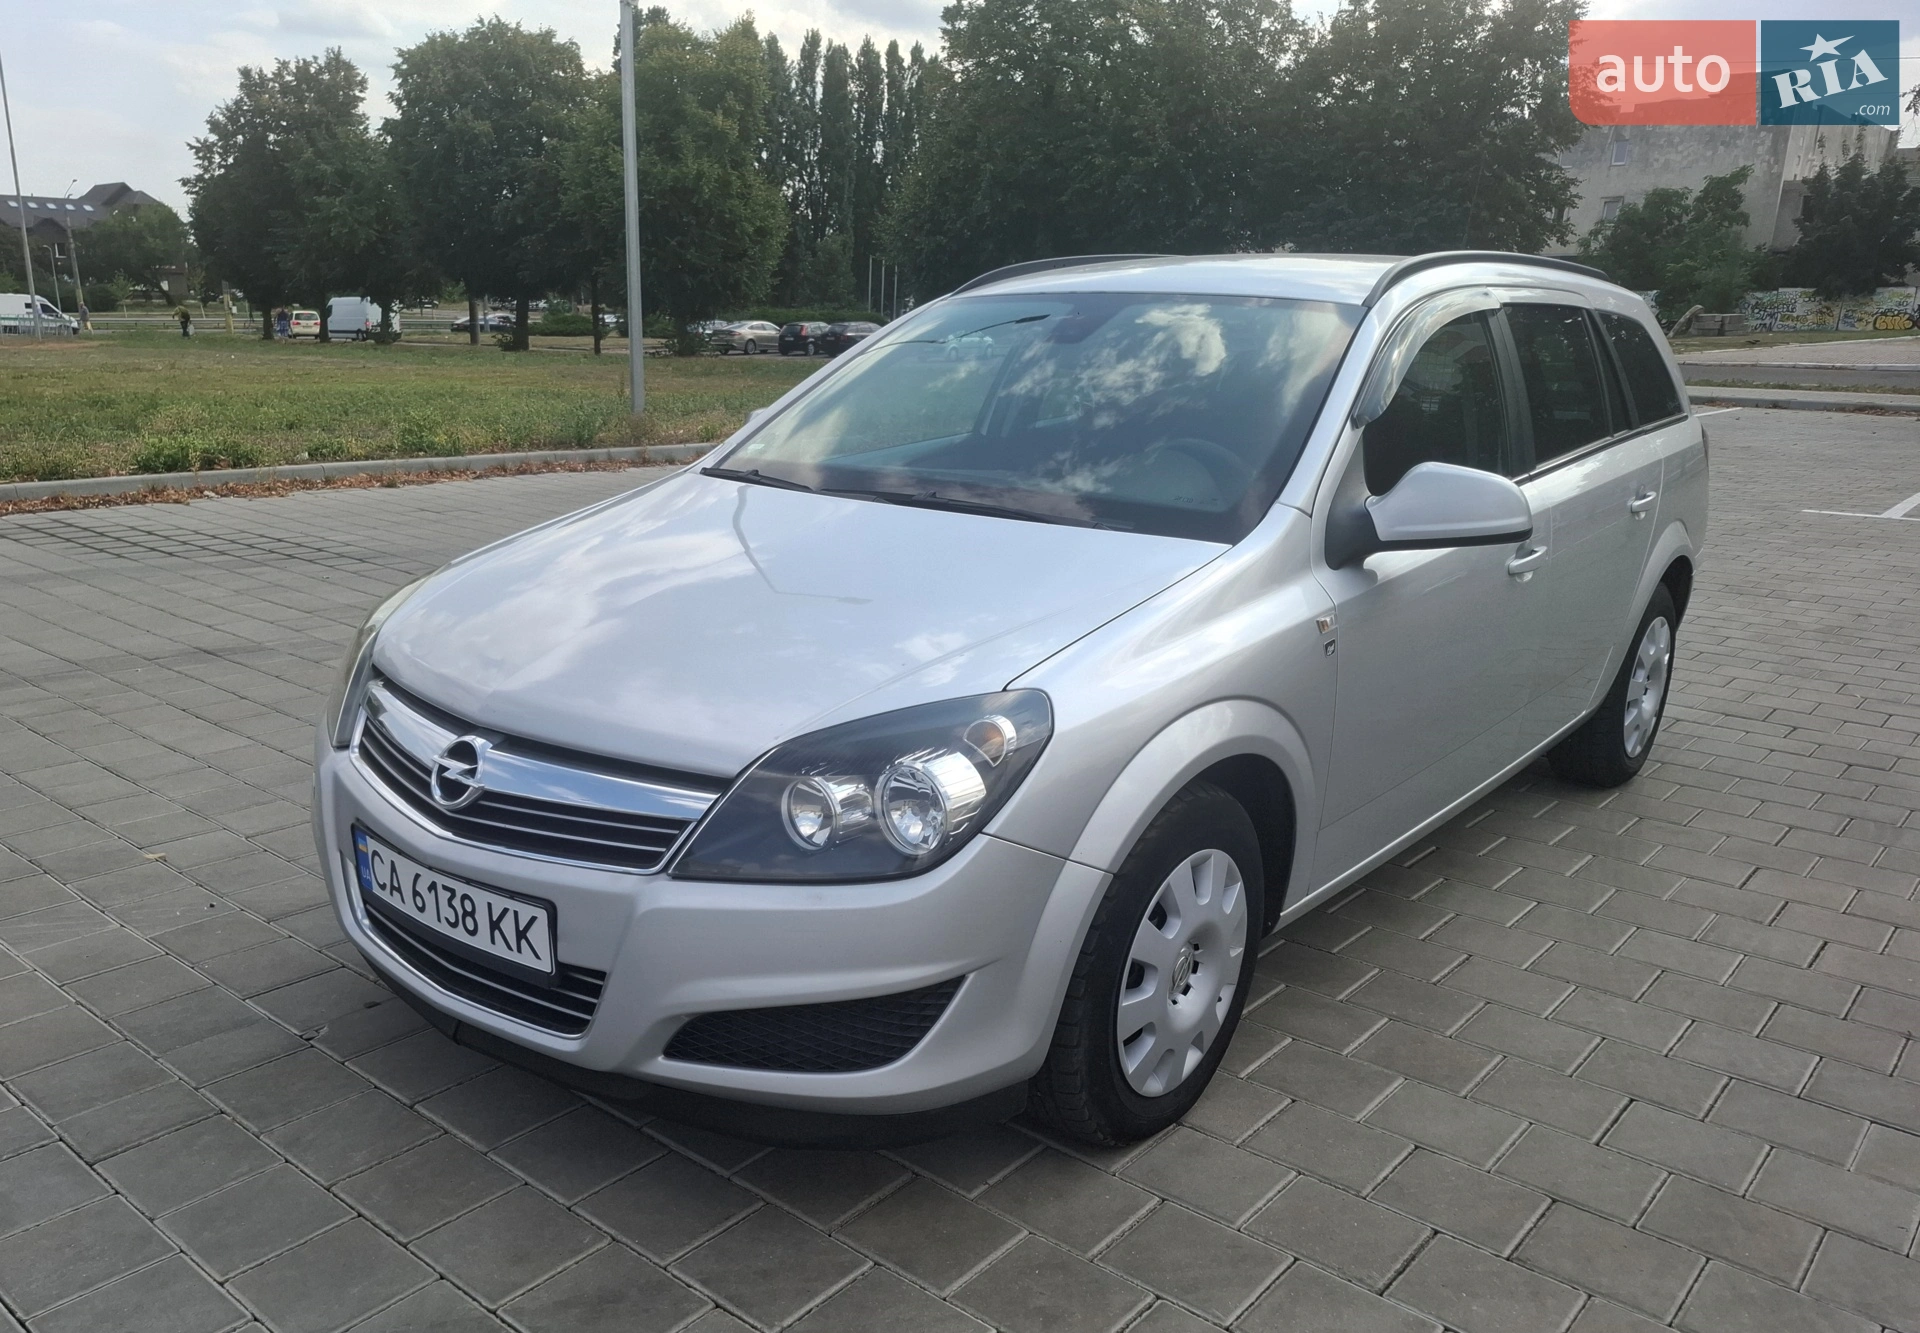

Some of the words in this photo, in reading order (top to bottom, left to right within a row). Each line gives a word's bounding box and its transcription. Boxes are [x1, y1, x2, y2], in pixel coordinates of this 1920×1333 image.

[361, 865, 371, 880] UA
[371, 849, 406, 905] CA
[411, 872, 479, 937] 6138
[487, 901, 542, 961] KK
